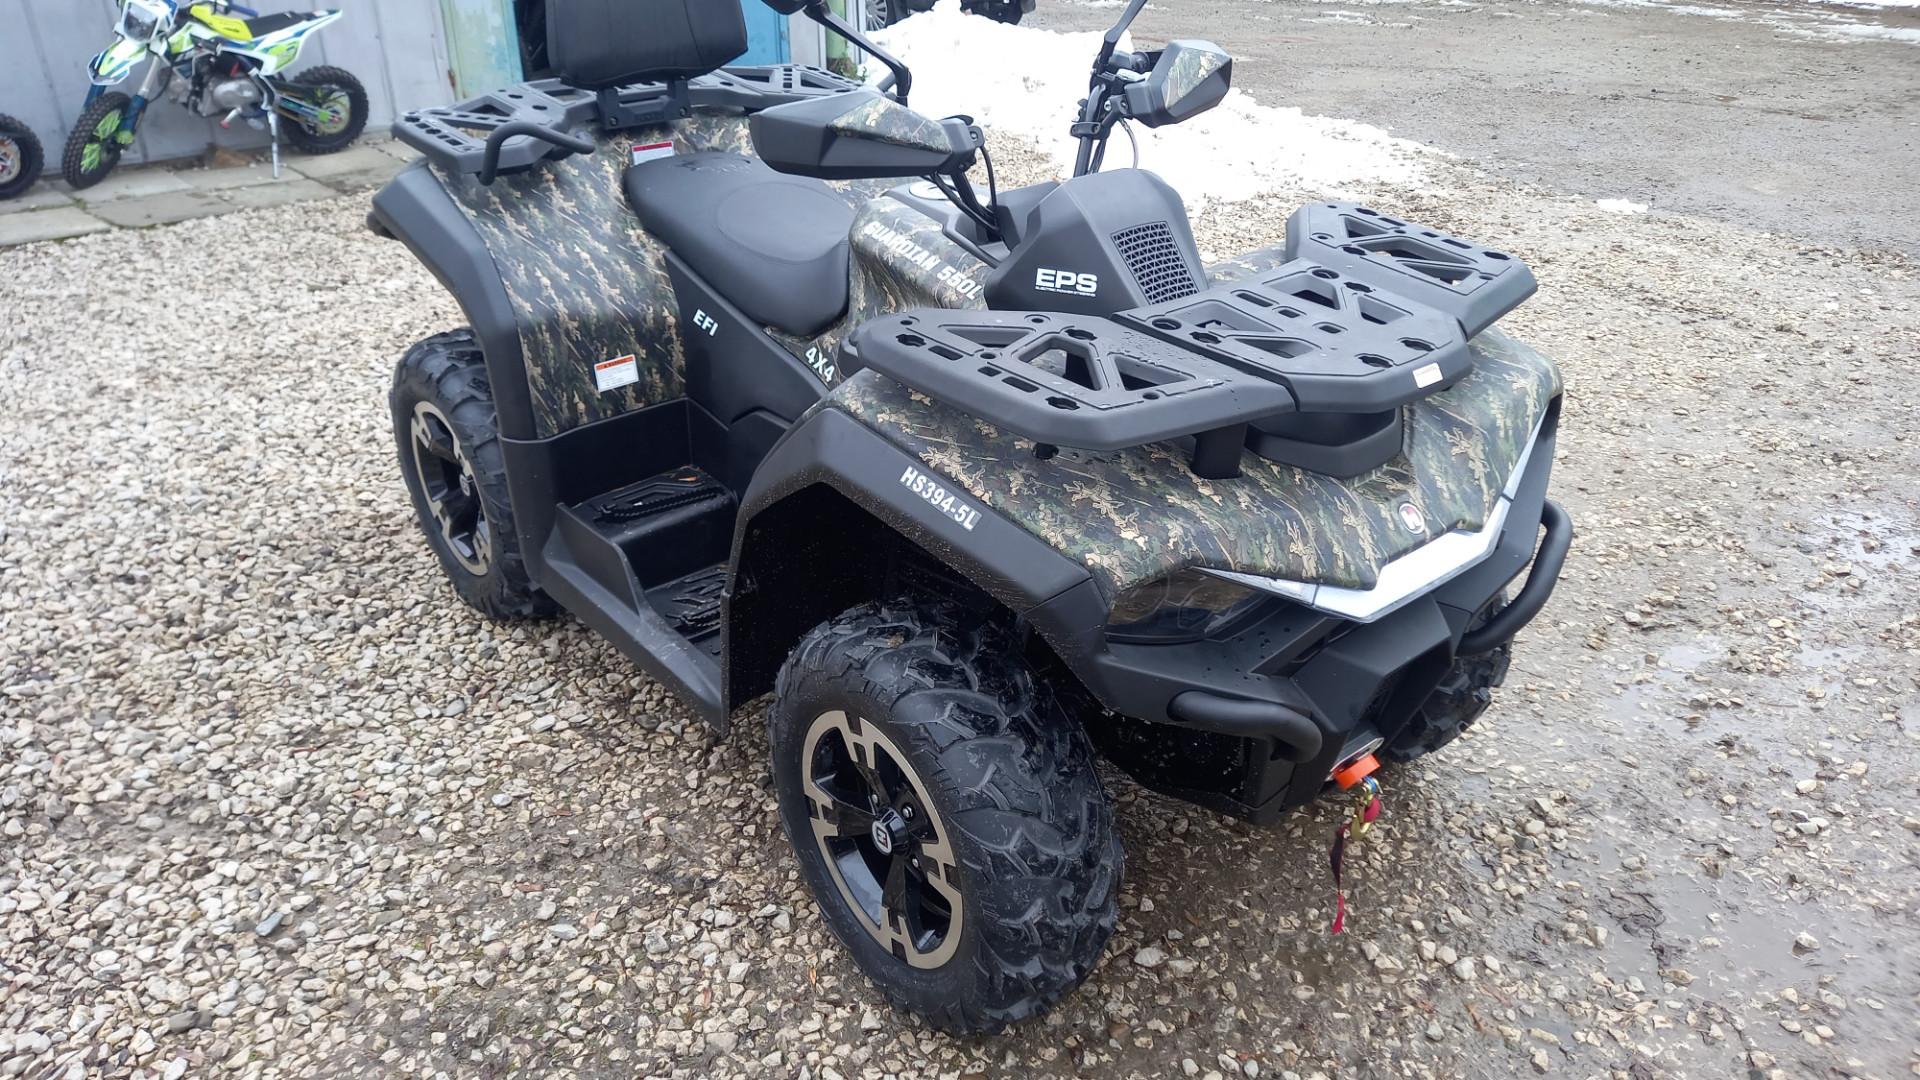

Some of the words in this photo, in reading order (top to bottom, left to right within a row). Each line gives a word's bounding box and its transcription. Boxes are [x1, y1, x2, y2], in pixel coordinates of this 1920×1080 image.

[863, 221, 941, 271] GUARDIAN
[937, 265, 982, 300] 550L
[1035, 268, 1098, 293] EPS
[692, 309, 719, 337] EFI
[805, 347, 835, 382] 4X4
[900, 465, 976, 531] HS394-5L
